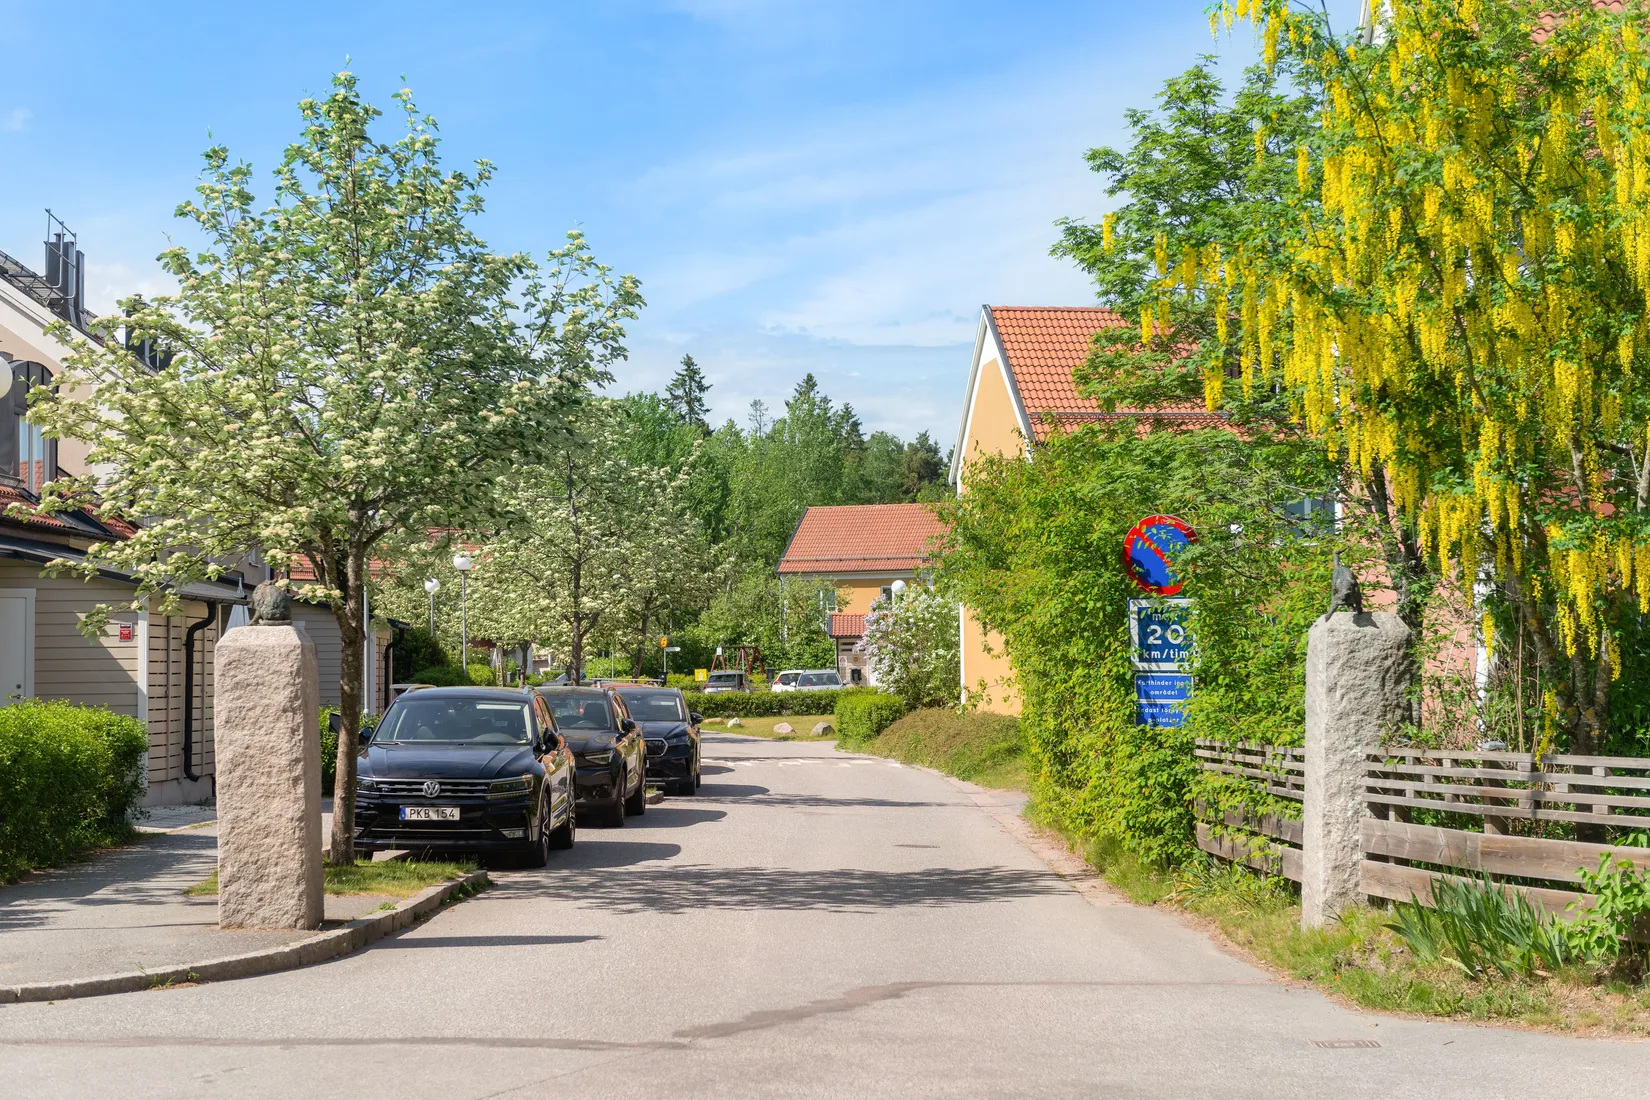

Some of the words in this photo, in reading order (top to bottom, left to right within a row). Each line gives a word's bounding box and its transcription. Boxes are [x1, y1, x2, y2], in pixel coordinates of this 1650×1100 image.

[1152, 613, 1178, 621] mx
[1147, 624, 1184, 645] 20
[1143, 648, 1189, 659] km/tim
[409, 808, 430, 819] PKB
[435, 808, 455, 819] 154
